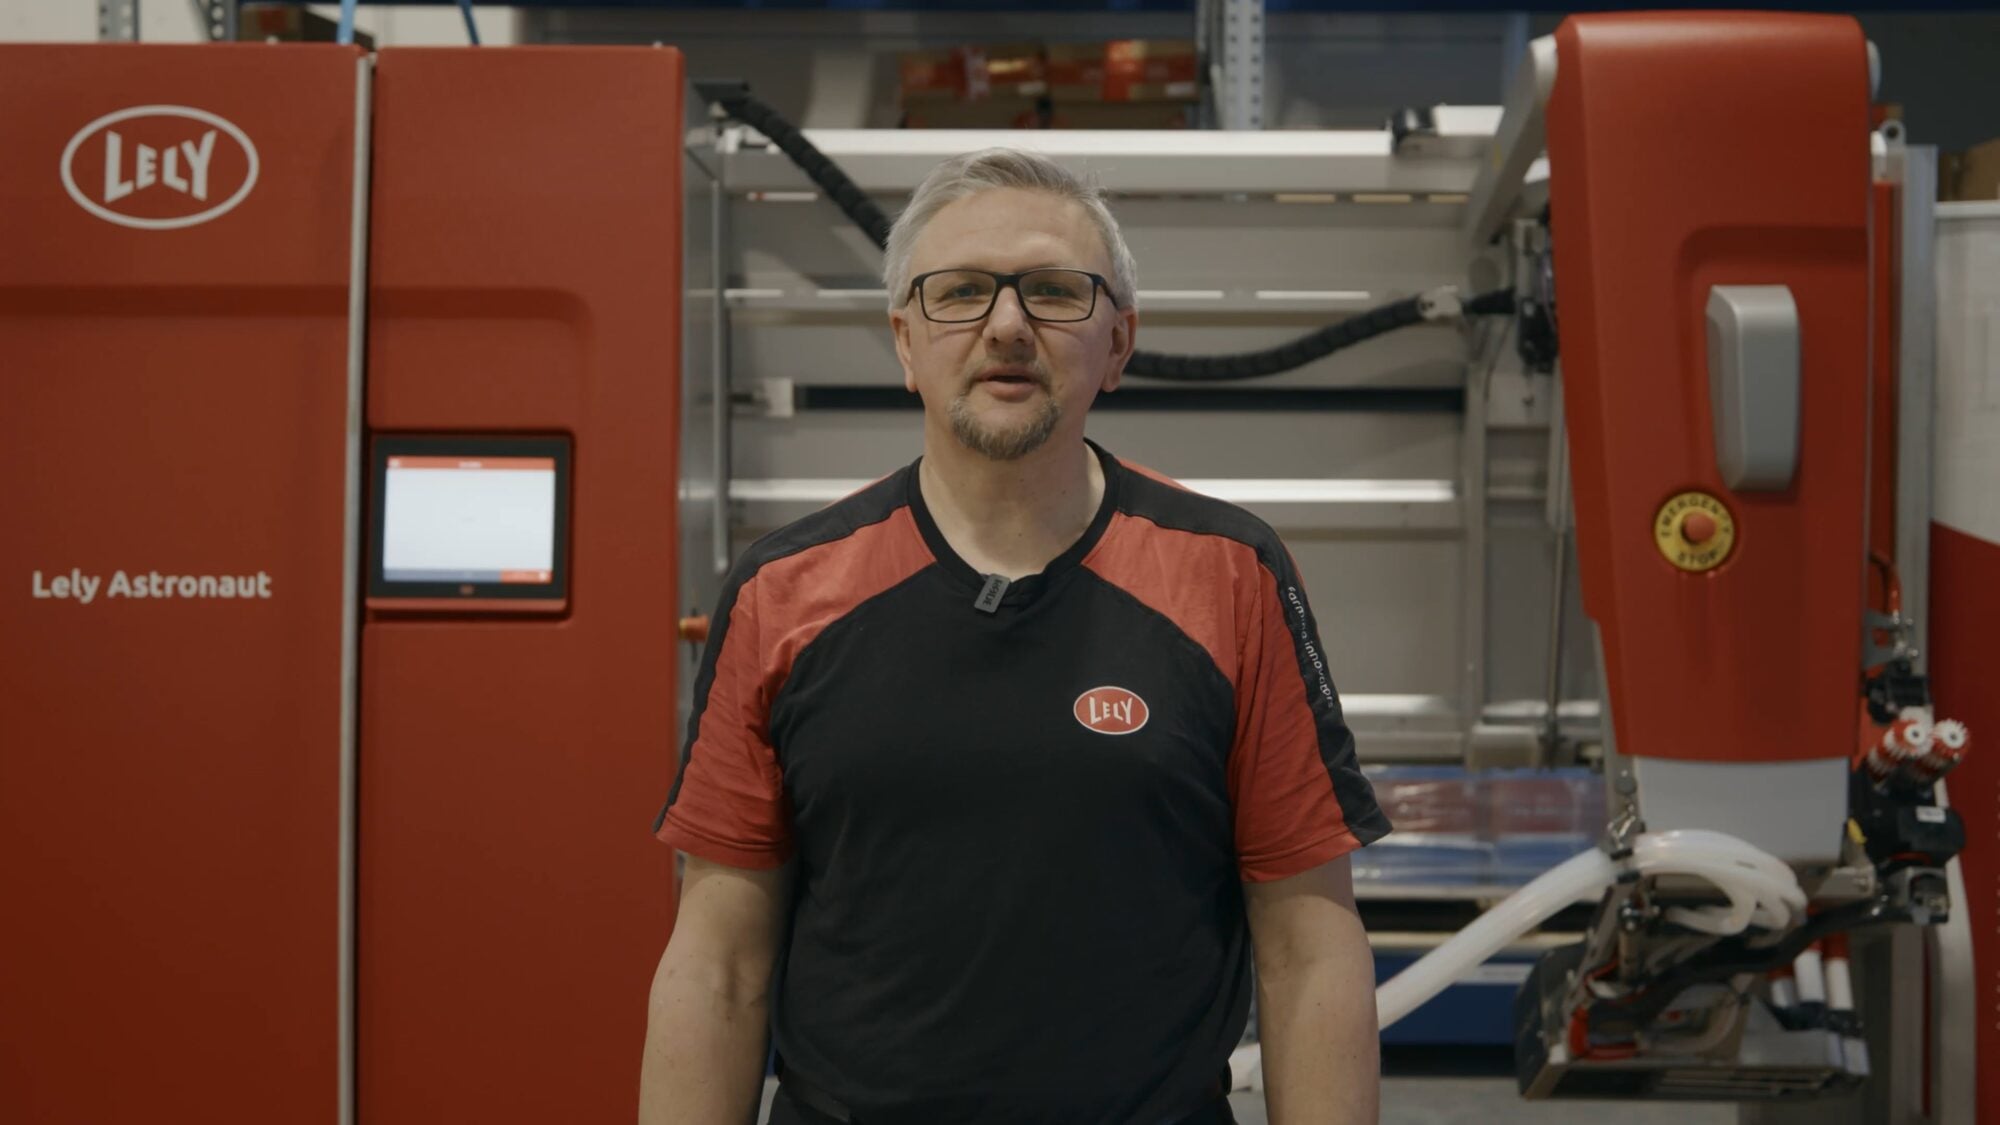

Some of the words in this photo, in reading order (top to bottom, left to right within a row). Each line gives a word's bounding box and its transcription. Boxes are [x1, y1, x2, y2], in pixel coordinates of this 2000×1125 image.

[104, 128, 218, 204] LELY
[1677, 547, 1719, 566] STOP
[32, 567, 101, 604] Lely
[107, 570, 272, 599] Astronaut
[1304, 640, 1334, 709] innovators
[1089, 696, 1133, 725] LELY
